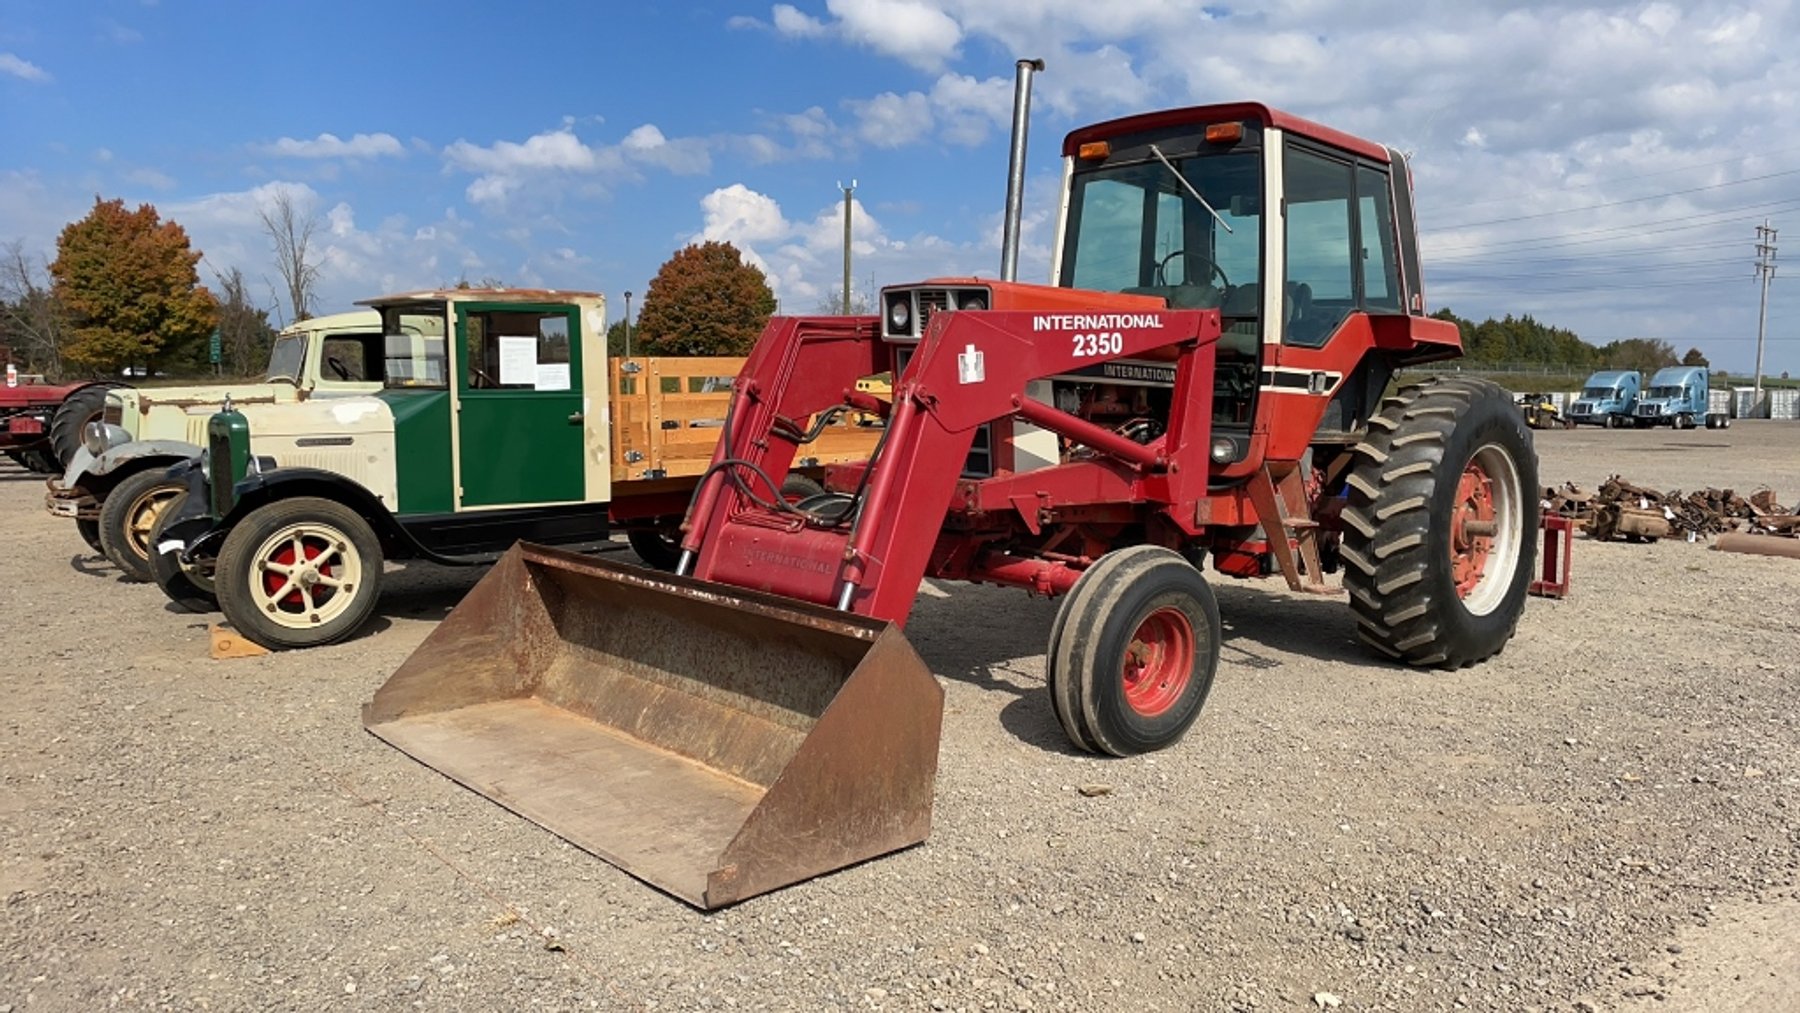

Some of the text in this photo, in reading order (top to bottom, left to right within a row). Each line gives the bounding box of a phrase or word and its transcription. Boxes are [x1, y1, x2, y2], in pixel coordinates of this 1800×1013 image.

[1033, 314, 1163, 331] INTERNATIONAL
[1072, 332, 1123, 357] 2350
[1104, 364, 1175, 381] INTERNATIONA
[744, 546, 832, 574] INTERNATIONAL
